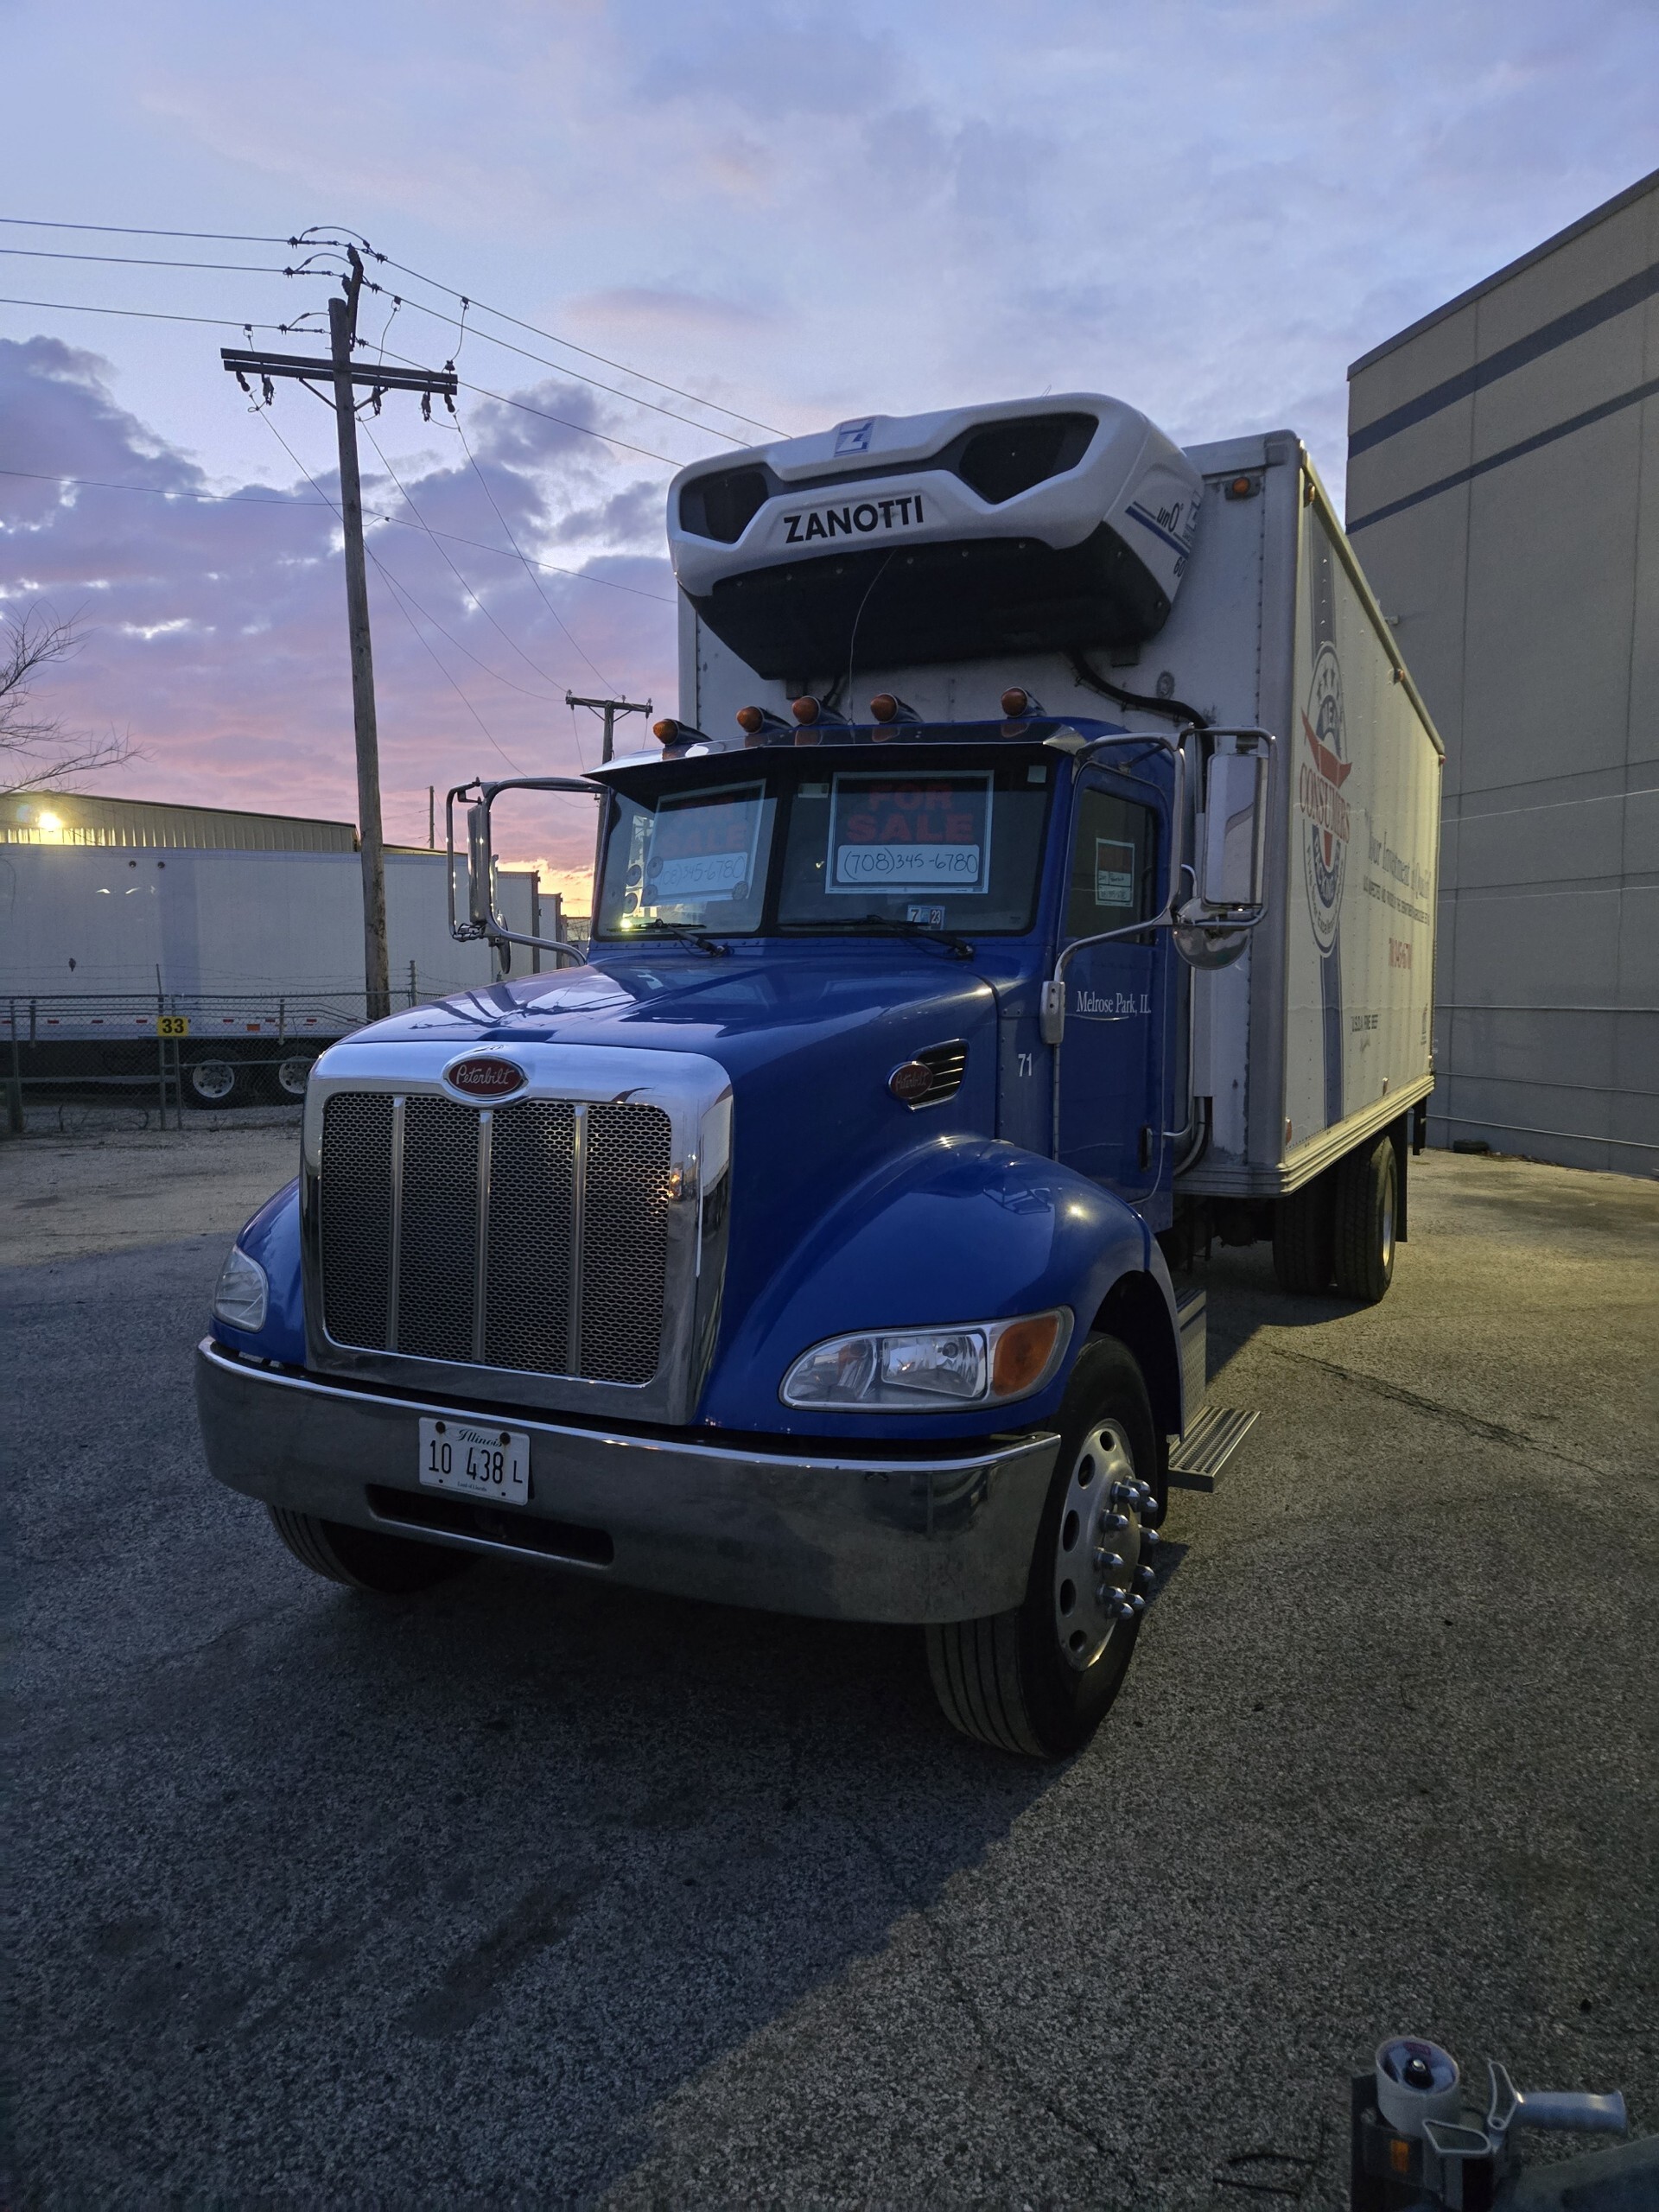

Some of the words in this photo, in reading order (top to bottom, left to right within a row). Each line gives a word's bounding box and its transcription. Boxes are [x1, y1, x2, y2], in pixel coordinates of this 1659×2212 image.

[784, 495, 924, 543] ZANOTTI
[868, 782, 952, 810] FOR
[1300, 762, 1351, 843] CONSUMERS
[846, 813, 975, 843] SALE
[931, 910, 941, 925] 23
[1076, 991, 1113, 1013] Melrose
[1116, 993, 1137, 1016] Park,
[162, 1019, 184, 1033] 33
[455, 1065, 515, 1085] Peterbilt
[1018, 1052, 1033, 1077] 71
[456, 1429, 502, 1447] Illinois
[429, 1440, 452, 1474] 10
[467, 1447, 504, 1484] 438
[513, 1460, 523, 1484] L
